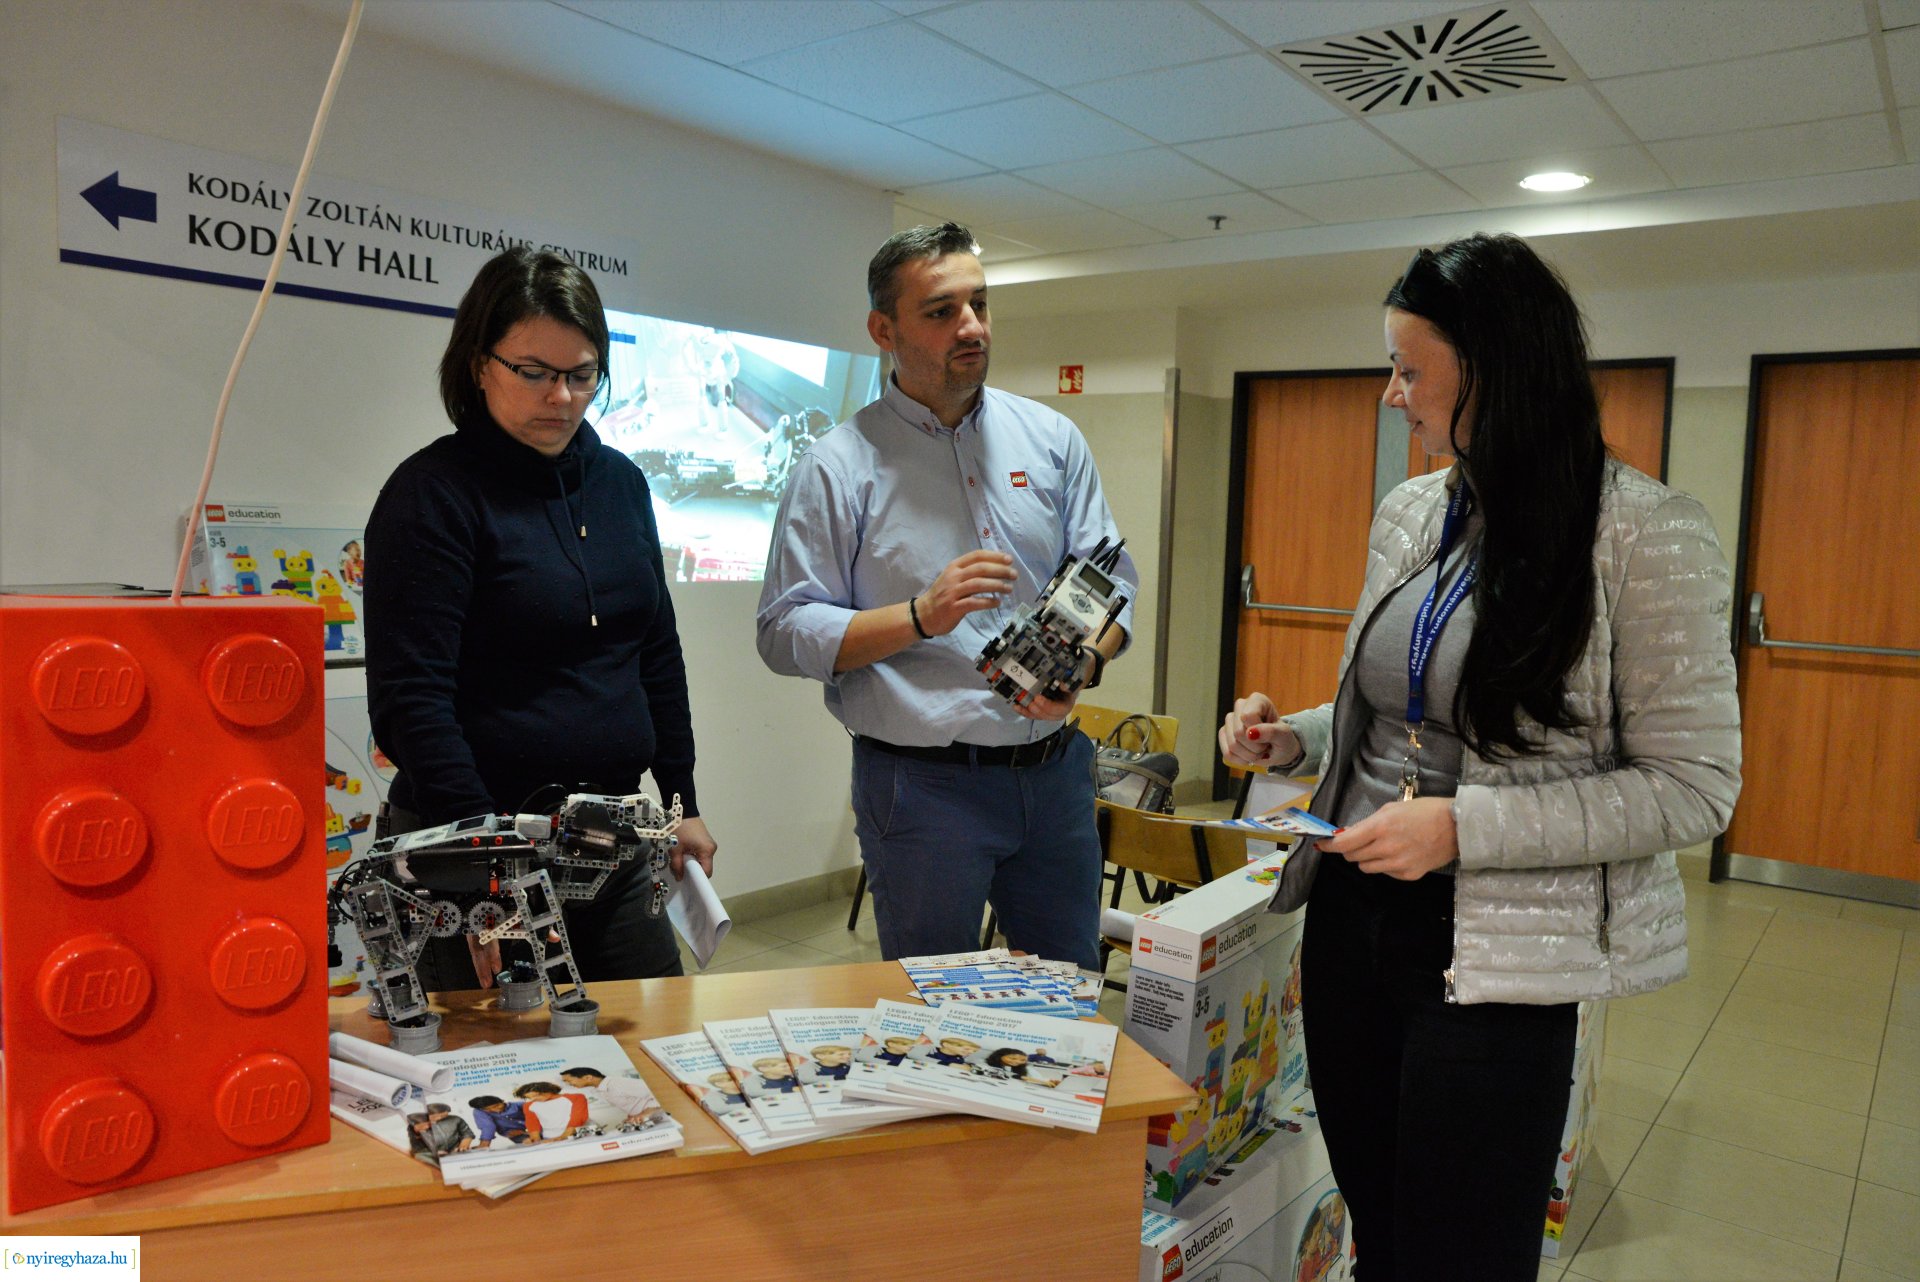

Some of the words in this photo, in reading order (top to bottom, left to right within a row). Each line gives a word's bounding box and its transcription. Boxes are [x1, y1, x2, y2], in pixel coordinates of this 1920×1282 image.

[307, 196, 402, 233] ZOLTÁN
[188, 213, 345, 268] KODÁLY
[358, 244, 439, 284] HALL
[228, 508, 282, 520] education
[209, 537, 227, 549] 3-5
[50, 667, 134, 711] LEGO
[220, 662, 295, 702] LEGO
[53, 817, 137, 865] LEGO
[220, 804, 294, 847] LEGO
[1154, 944, 1193, 961] education
[1218, 921, 1257, 954] education
[222, 944, 296, 990] LEGO
[57, 965, 141, 1018] LEGO
[1195, 995, 1210, 1018] 3-5
[946, 1014, 994, 1025] Catalogue
[976, 1013, 1022, 1024] Education
[463, 1052, 517, 1063] Education
[228, 1079, 299, 1128] LEGO
[60, 1110, 143, 1166] LEGO
[1165, 1254, 1182, 1275] LEGO
[1185, 1215, 1234, 1262] education
